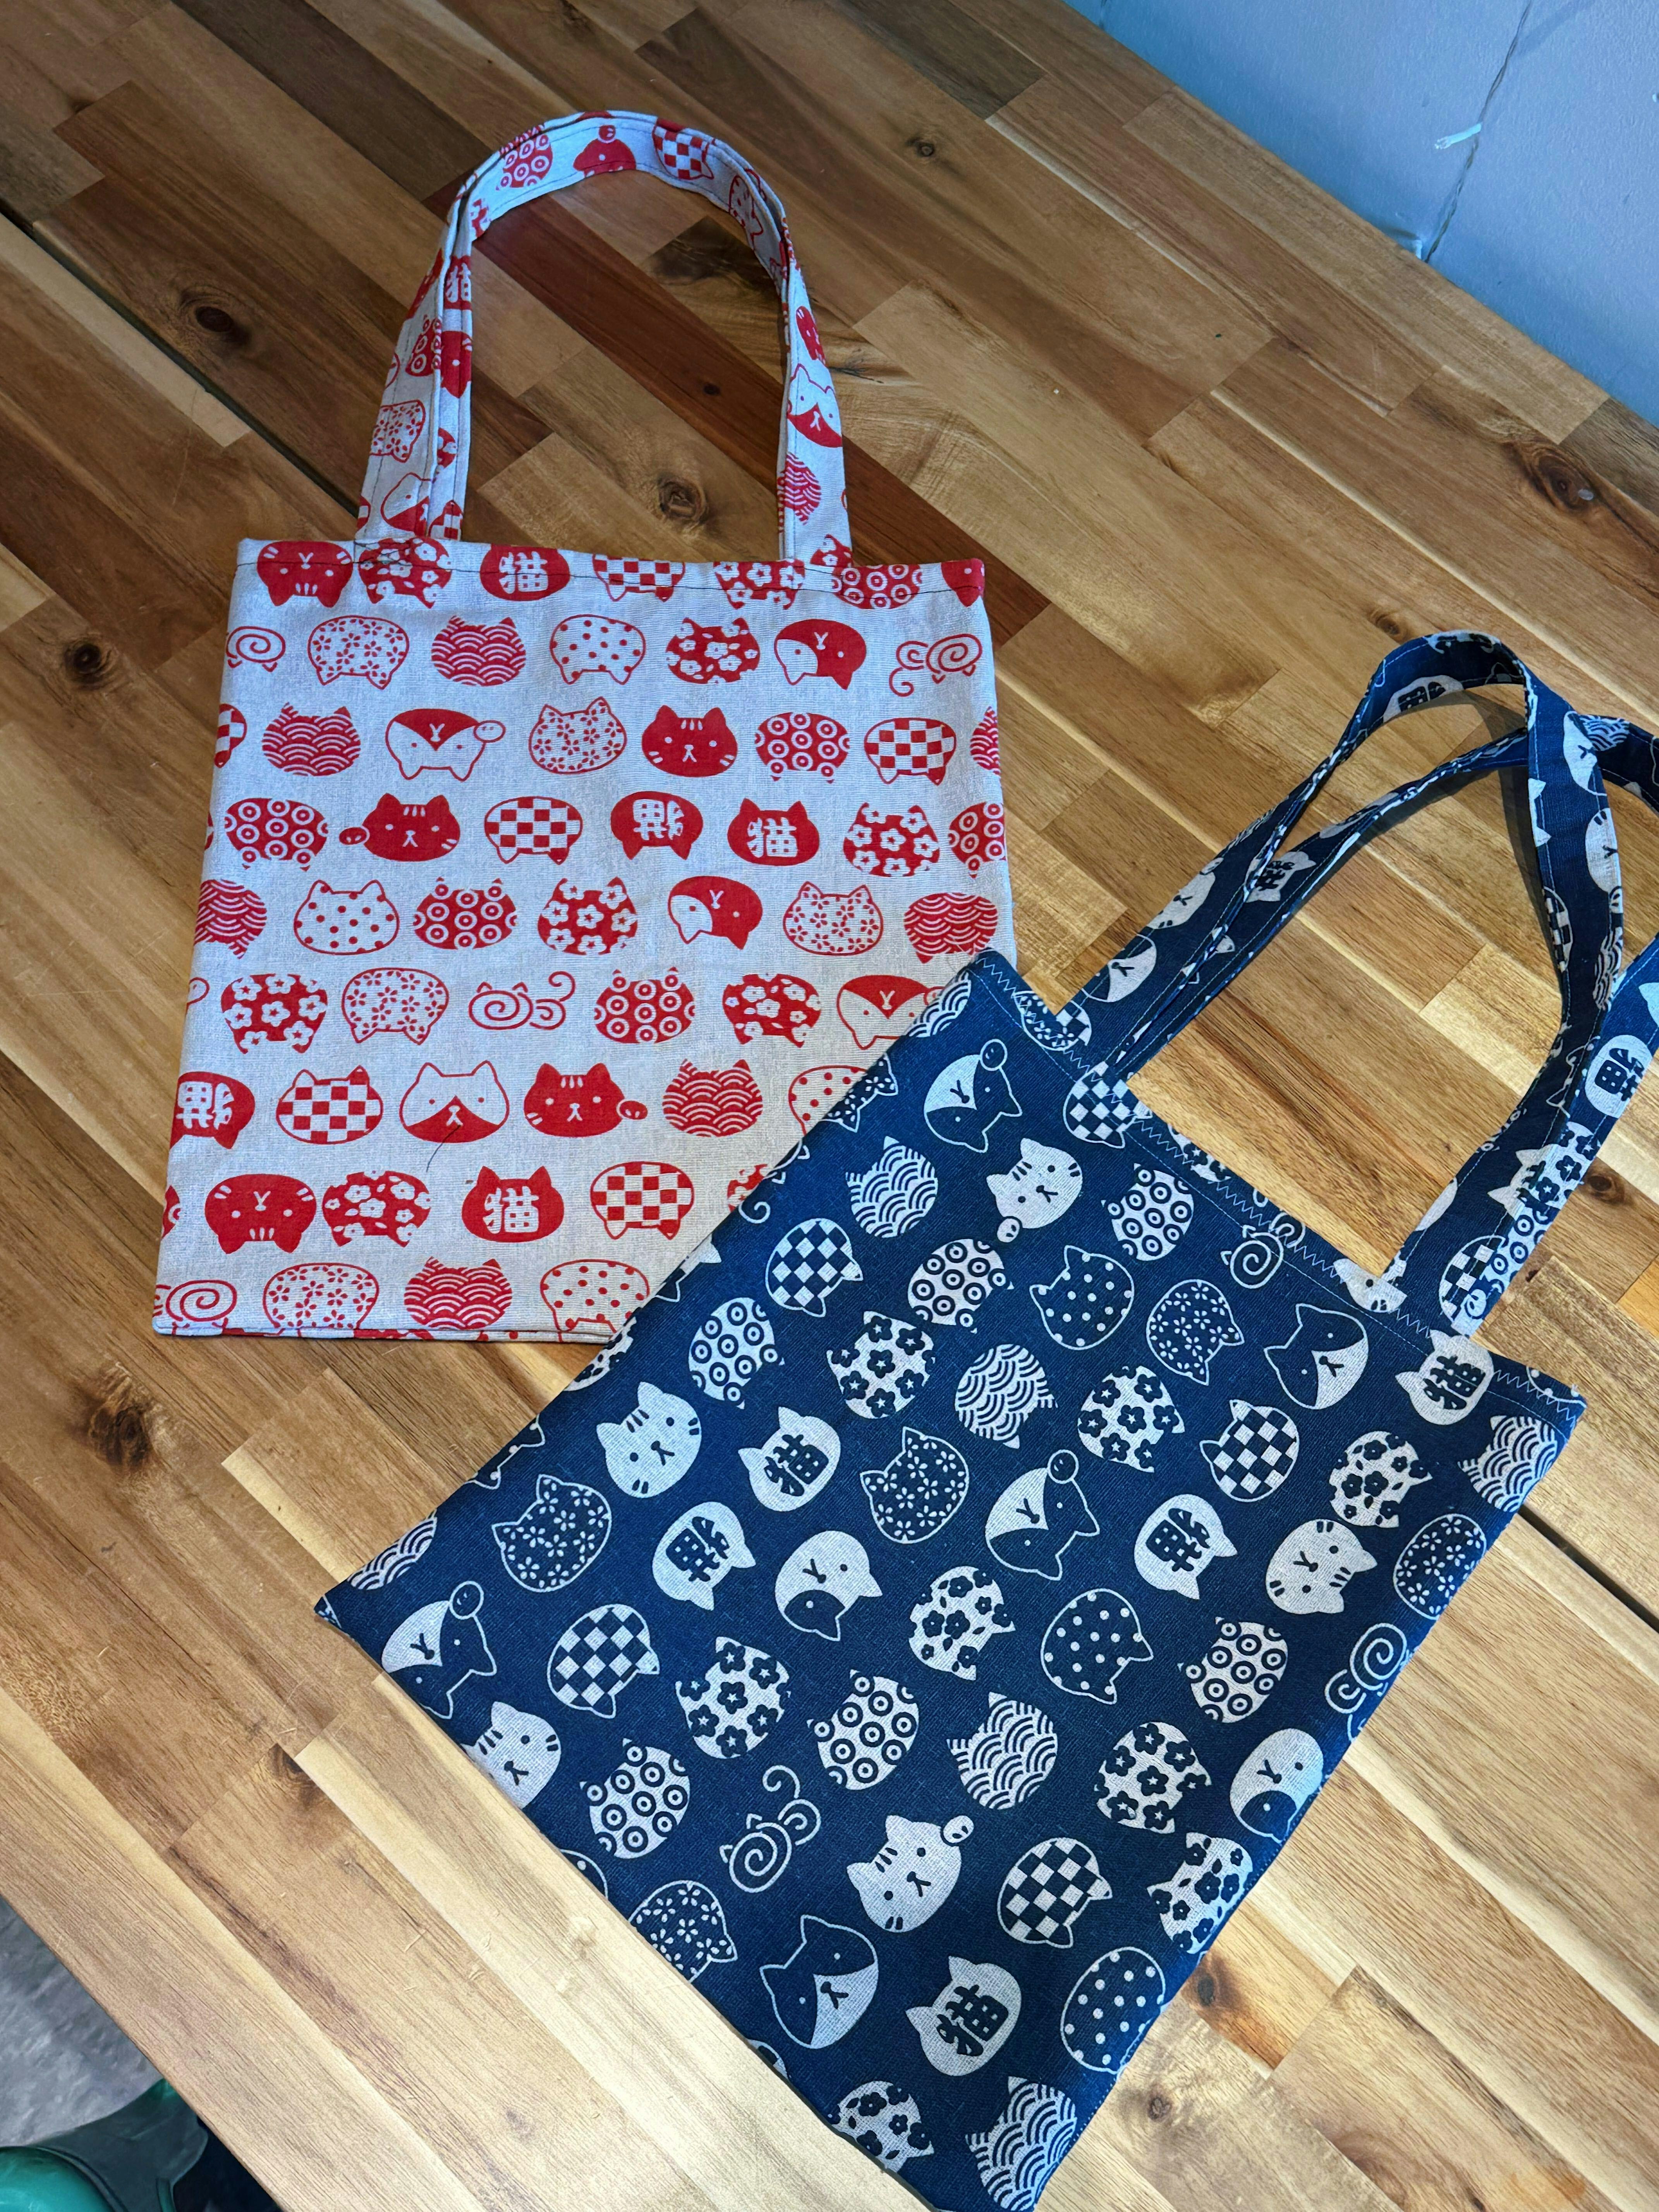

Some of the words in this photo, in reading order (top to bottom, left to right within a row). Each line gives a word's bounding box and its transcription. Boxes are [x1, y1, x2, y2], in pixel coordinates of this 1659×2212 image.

[499, 551, 548, 593] 猫
[634, 799, 684, 840] 猫
[747, 817, 798, 858] 猫
[175, 1081, 234, 1130] 猫
[483, 1186, 539, 1234] 猫
[1423, 1356, 1486, 1410] 猫
[764, 1434, 829, 1497] 猫
[666, 1516, 730, 1582] 猫
[1145, 1508, 1210, 1572] 猫
[937, 1984, 1008, 2057] 猫
